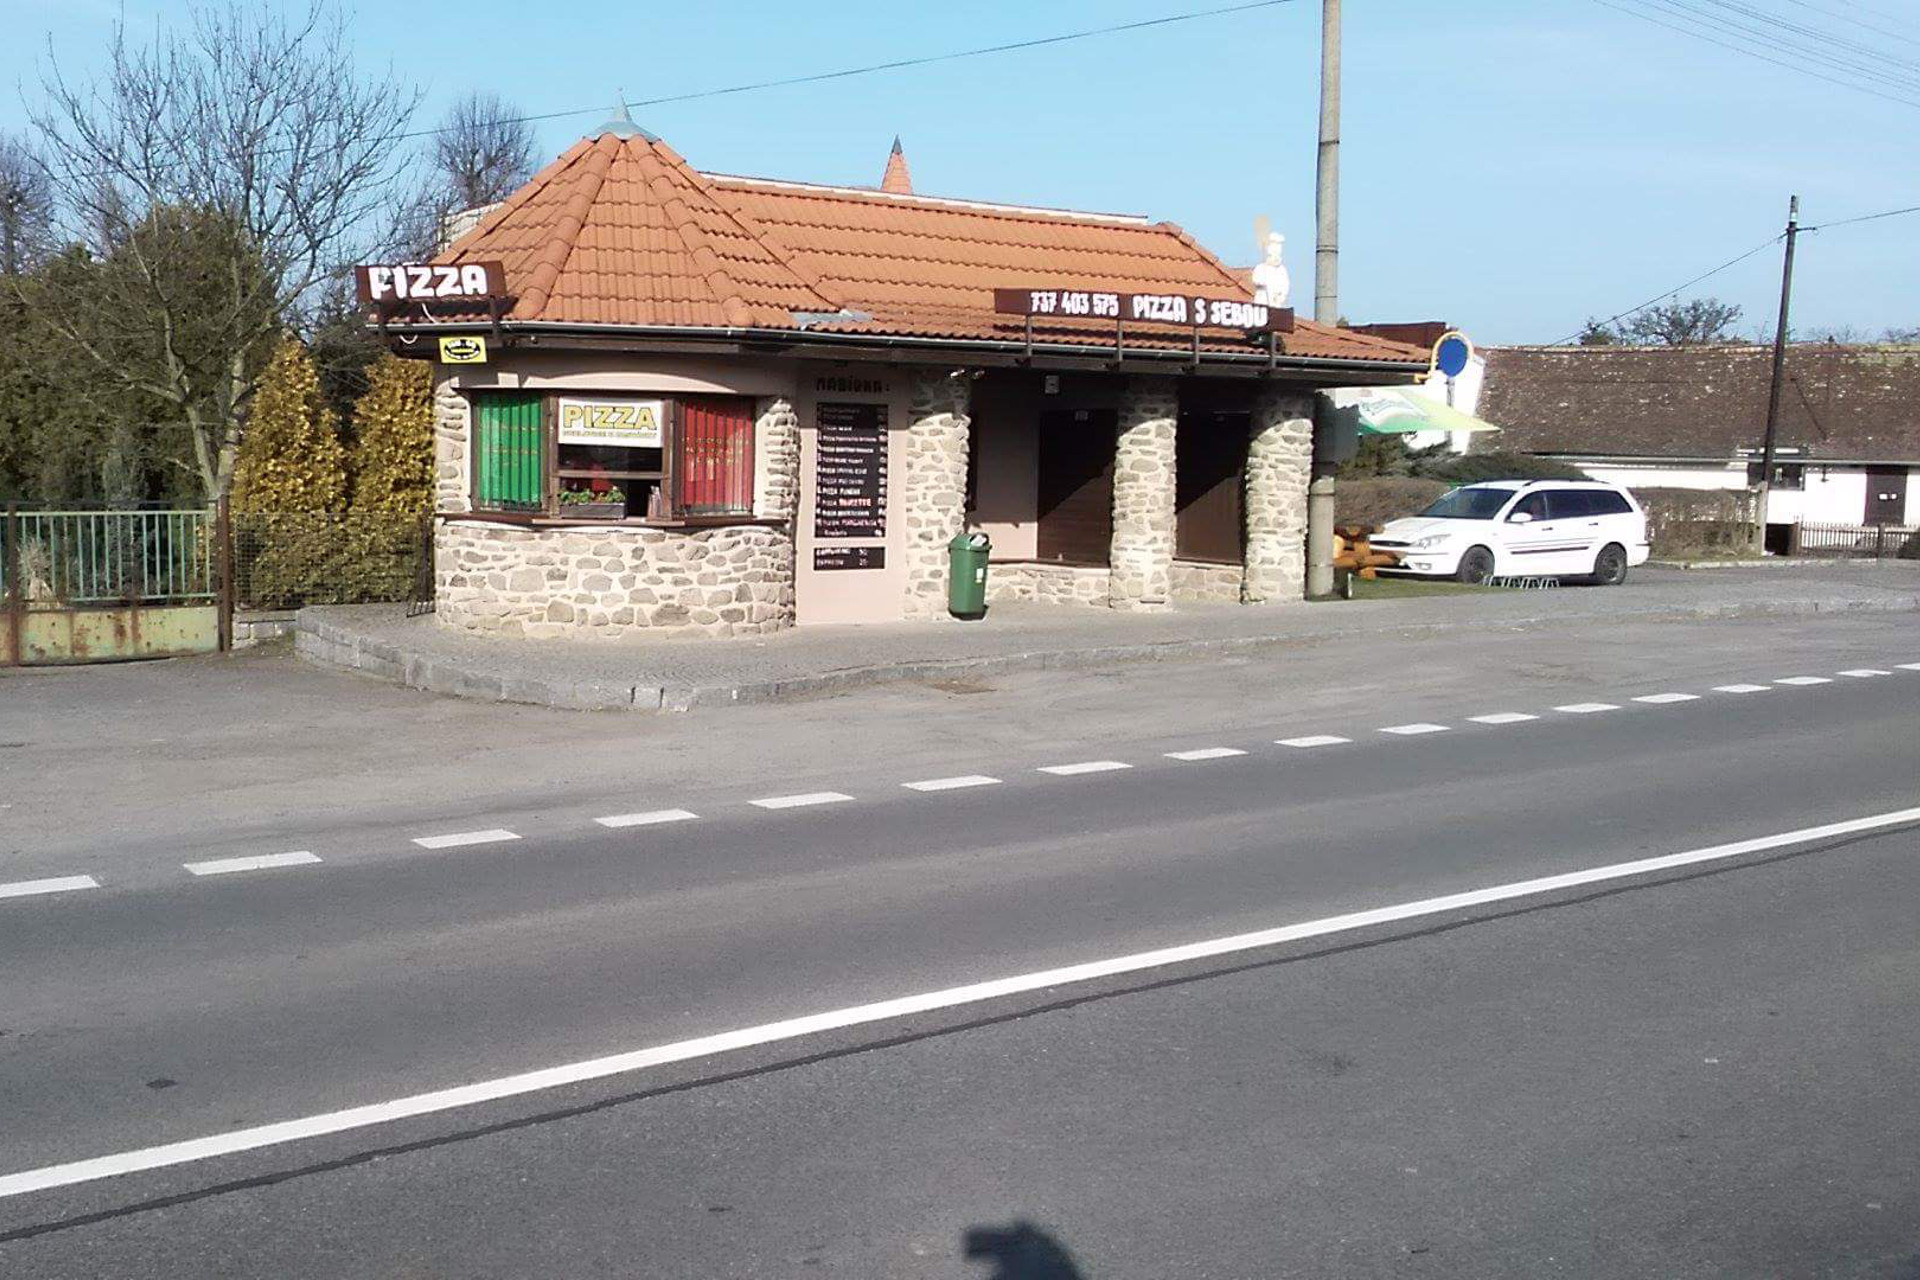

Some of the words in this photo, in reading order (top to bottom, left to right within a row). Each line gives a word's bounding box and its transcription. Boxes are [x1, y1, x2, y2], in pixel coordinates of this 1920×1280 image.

[368, 265, 488, 300] PIZZA
[1030, 291, 1058, 313] 737
[1061, 291, 1090, 315] 403
[1092, 293, 1120, 317] 575
[1132, 294, 1188, 323] PIZZA
[1194, 297, 1207, 325] S
[563, 404, 658, 431] PIZZA
